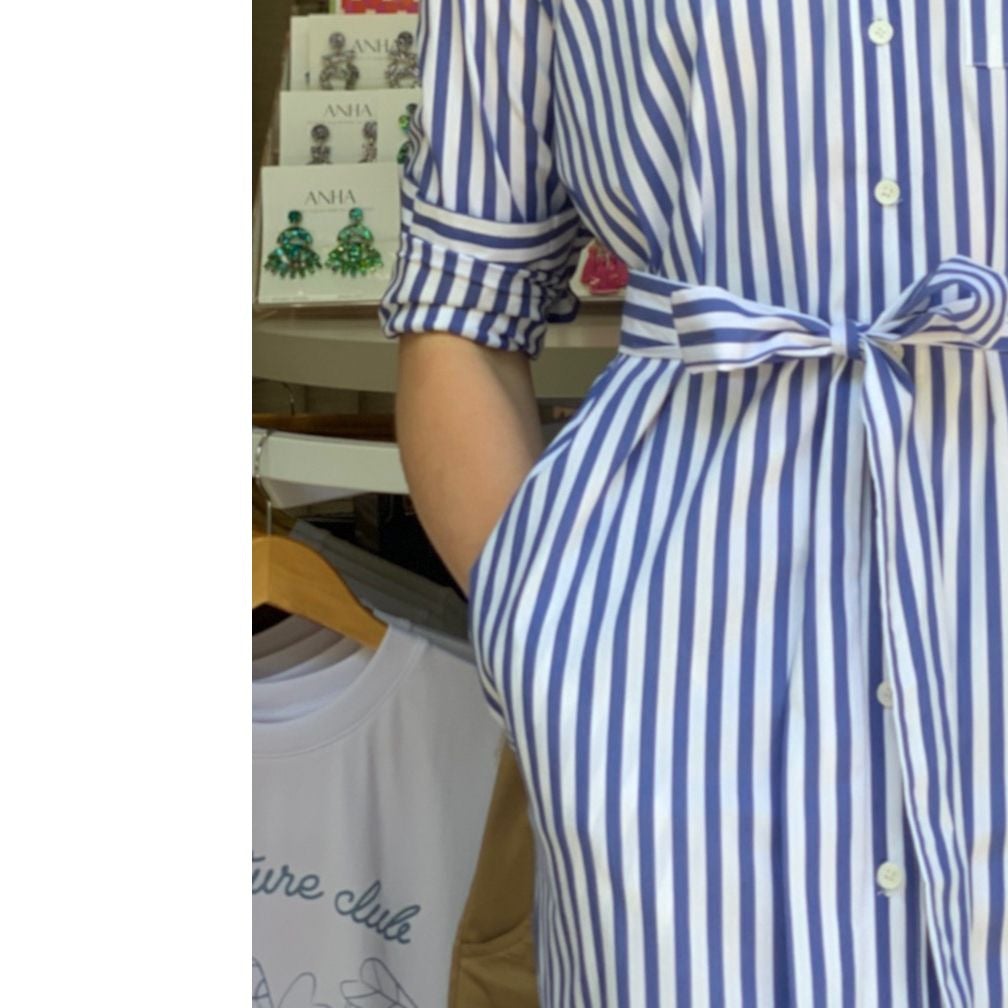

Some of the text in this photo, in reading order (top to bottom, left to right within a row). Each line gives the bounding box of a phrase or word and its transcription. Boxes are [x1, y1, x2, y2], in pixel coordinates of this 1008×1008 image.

[324, 103, 374, 118] ANHA
[304, 189, 357, 205] ANHA
[334, 879, 421, 945] club
